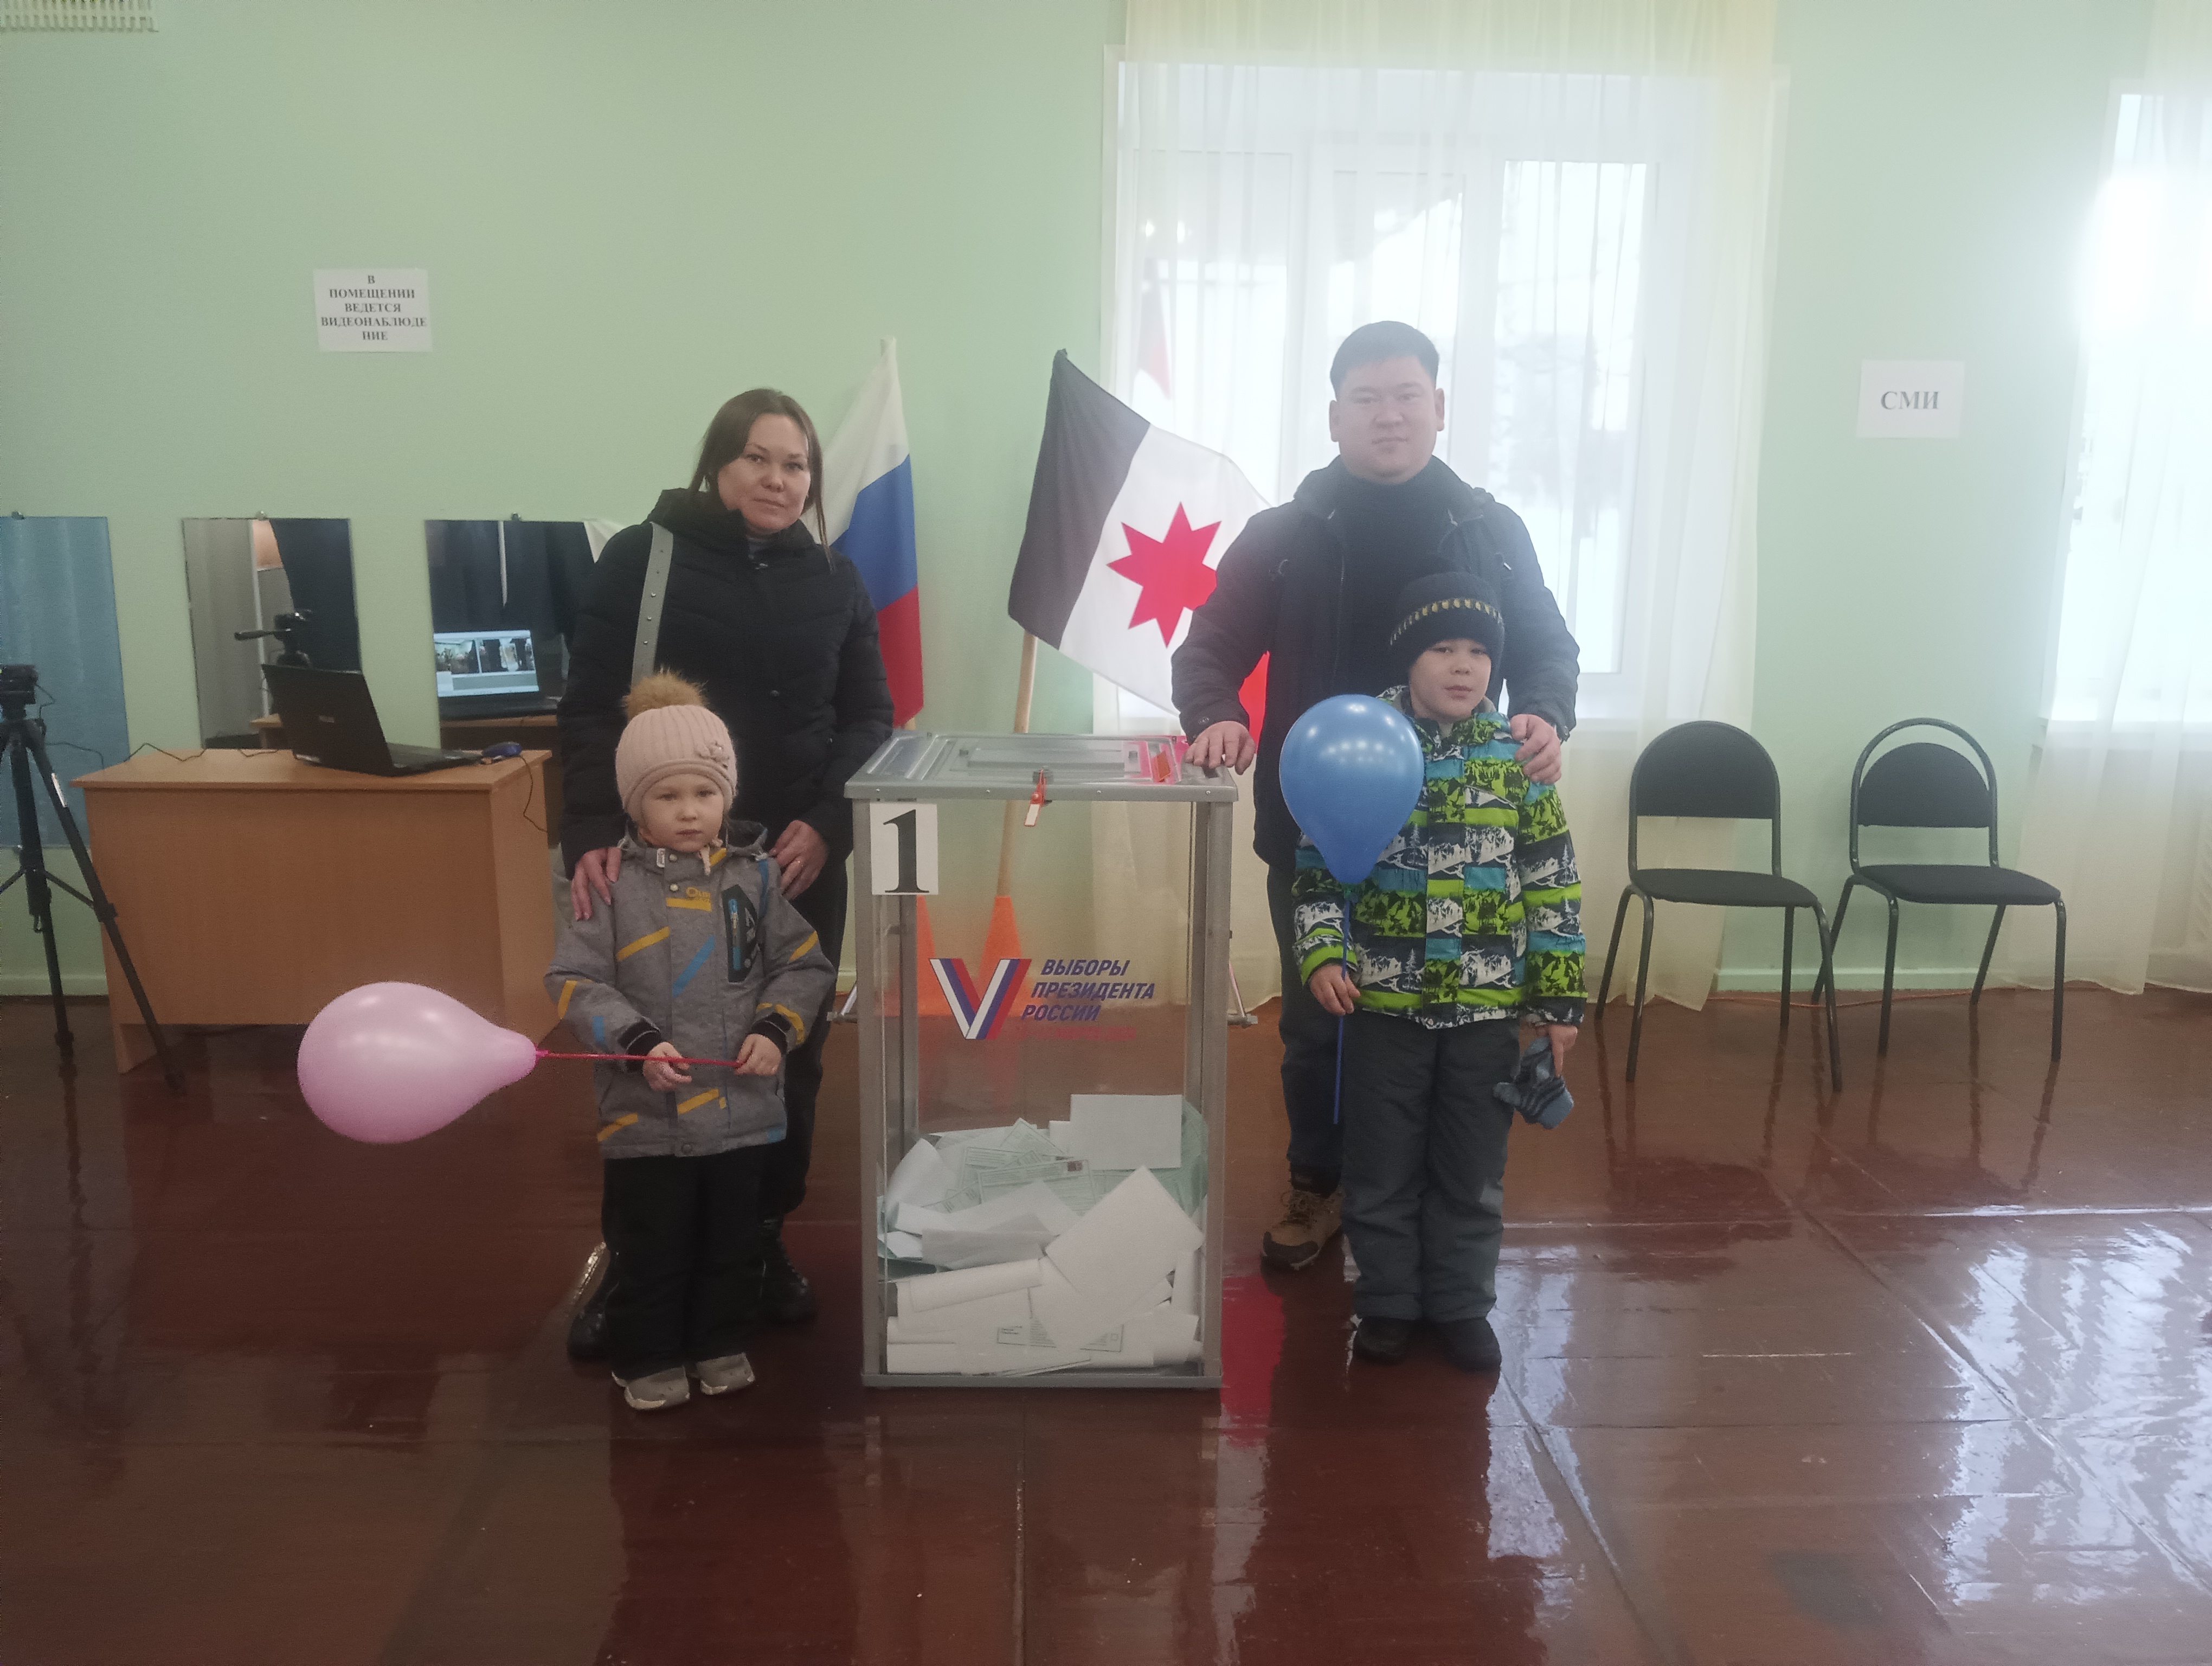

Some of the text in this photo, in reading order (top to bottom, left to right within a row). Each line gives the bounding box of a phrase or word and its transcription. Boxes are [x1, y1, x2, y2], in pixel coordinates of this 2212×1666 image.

[367, 274, 376, 285] В
[329, 289, 415, 300] ПОМЕЩЕНИИ
[344, 303, 401, 313] ВЕДЕТСЯ
[321, 316, 427, 328] ВИДЕОНАБЛЮДЕ
[362, 330, 388, 341] НИЕ
[1880, 390, 1940, 410] СМИ
[883, 809, 930, 893] 1
[1040, 959, 1130, 976] ВЫБОРЫ
[1031, 982, 1156, 1001] ПРЕЗИДЕНТА
[1021, 1004, 1102, 1021] РОССИИ
